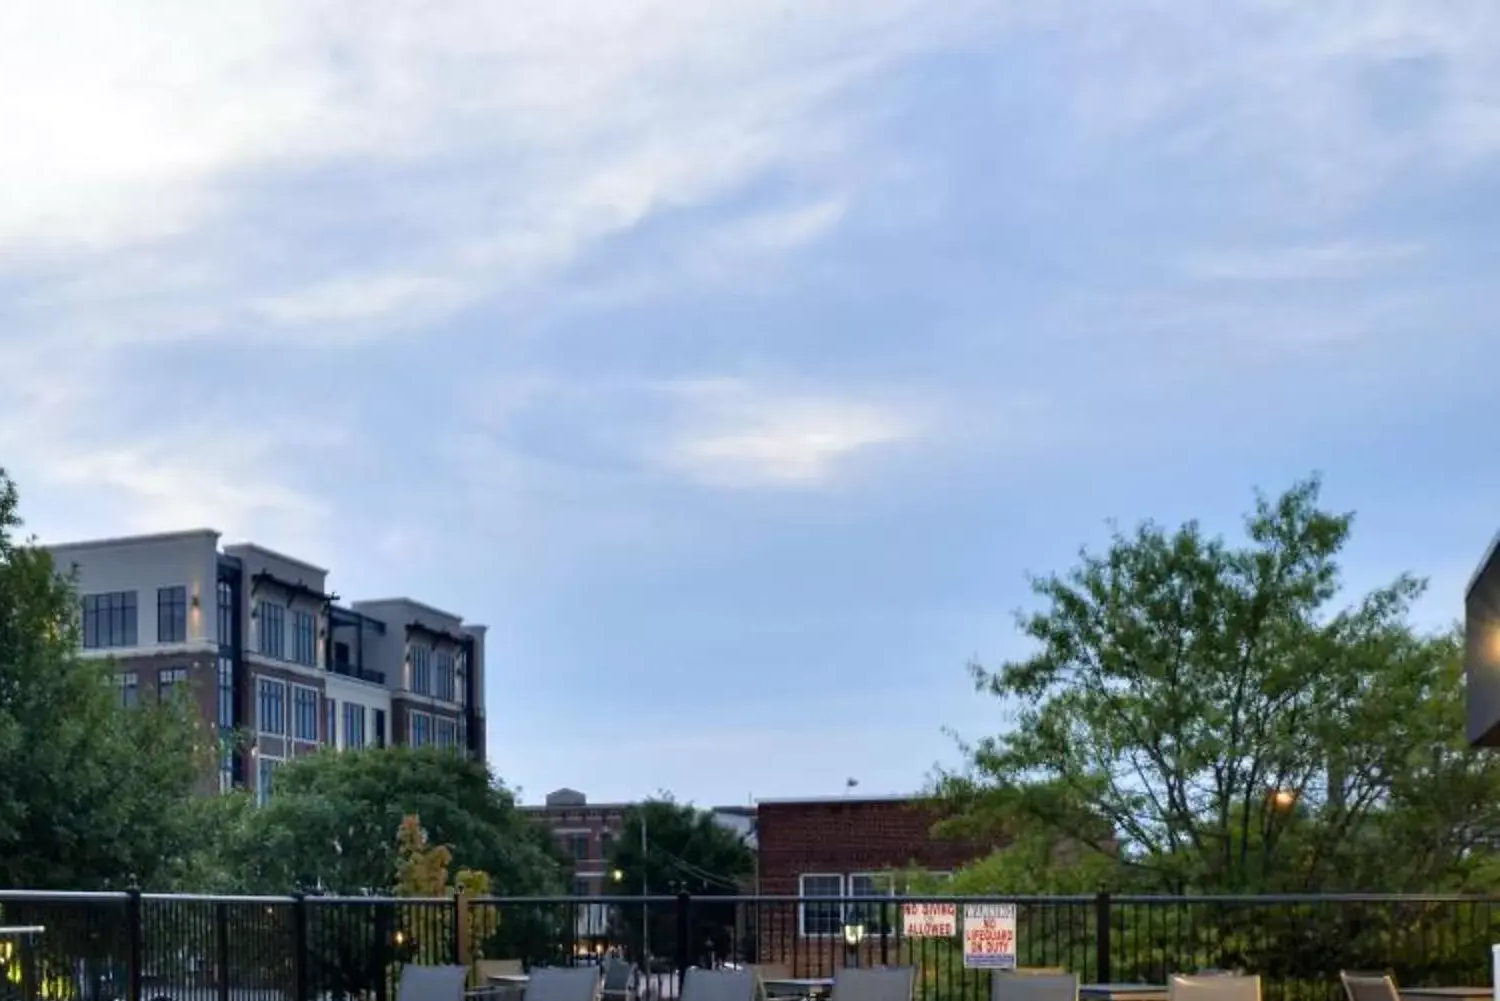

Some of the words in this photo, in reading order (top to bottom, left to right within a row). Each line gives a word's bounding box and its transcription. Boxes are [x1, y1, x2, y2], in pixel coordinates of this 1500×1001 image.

[903, 903, 919, 916] NO
[984, 918, 997, 929] NO
[908, 924, 952, 936] ALLOWED
[967, 929, 1013, 941] LIFEGUARD
[987, 941, 1009, 953] DUTY
